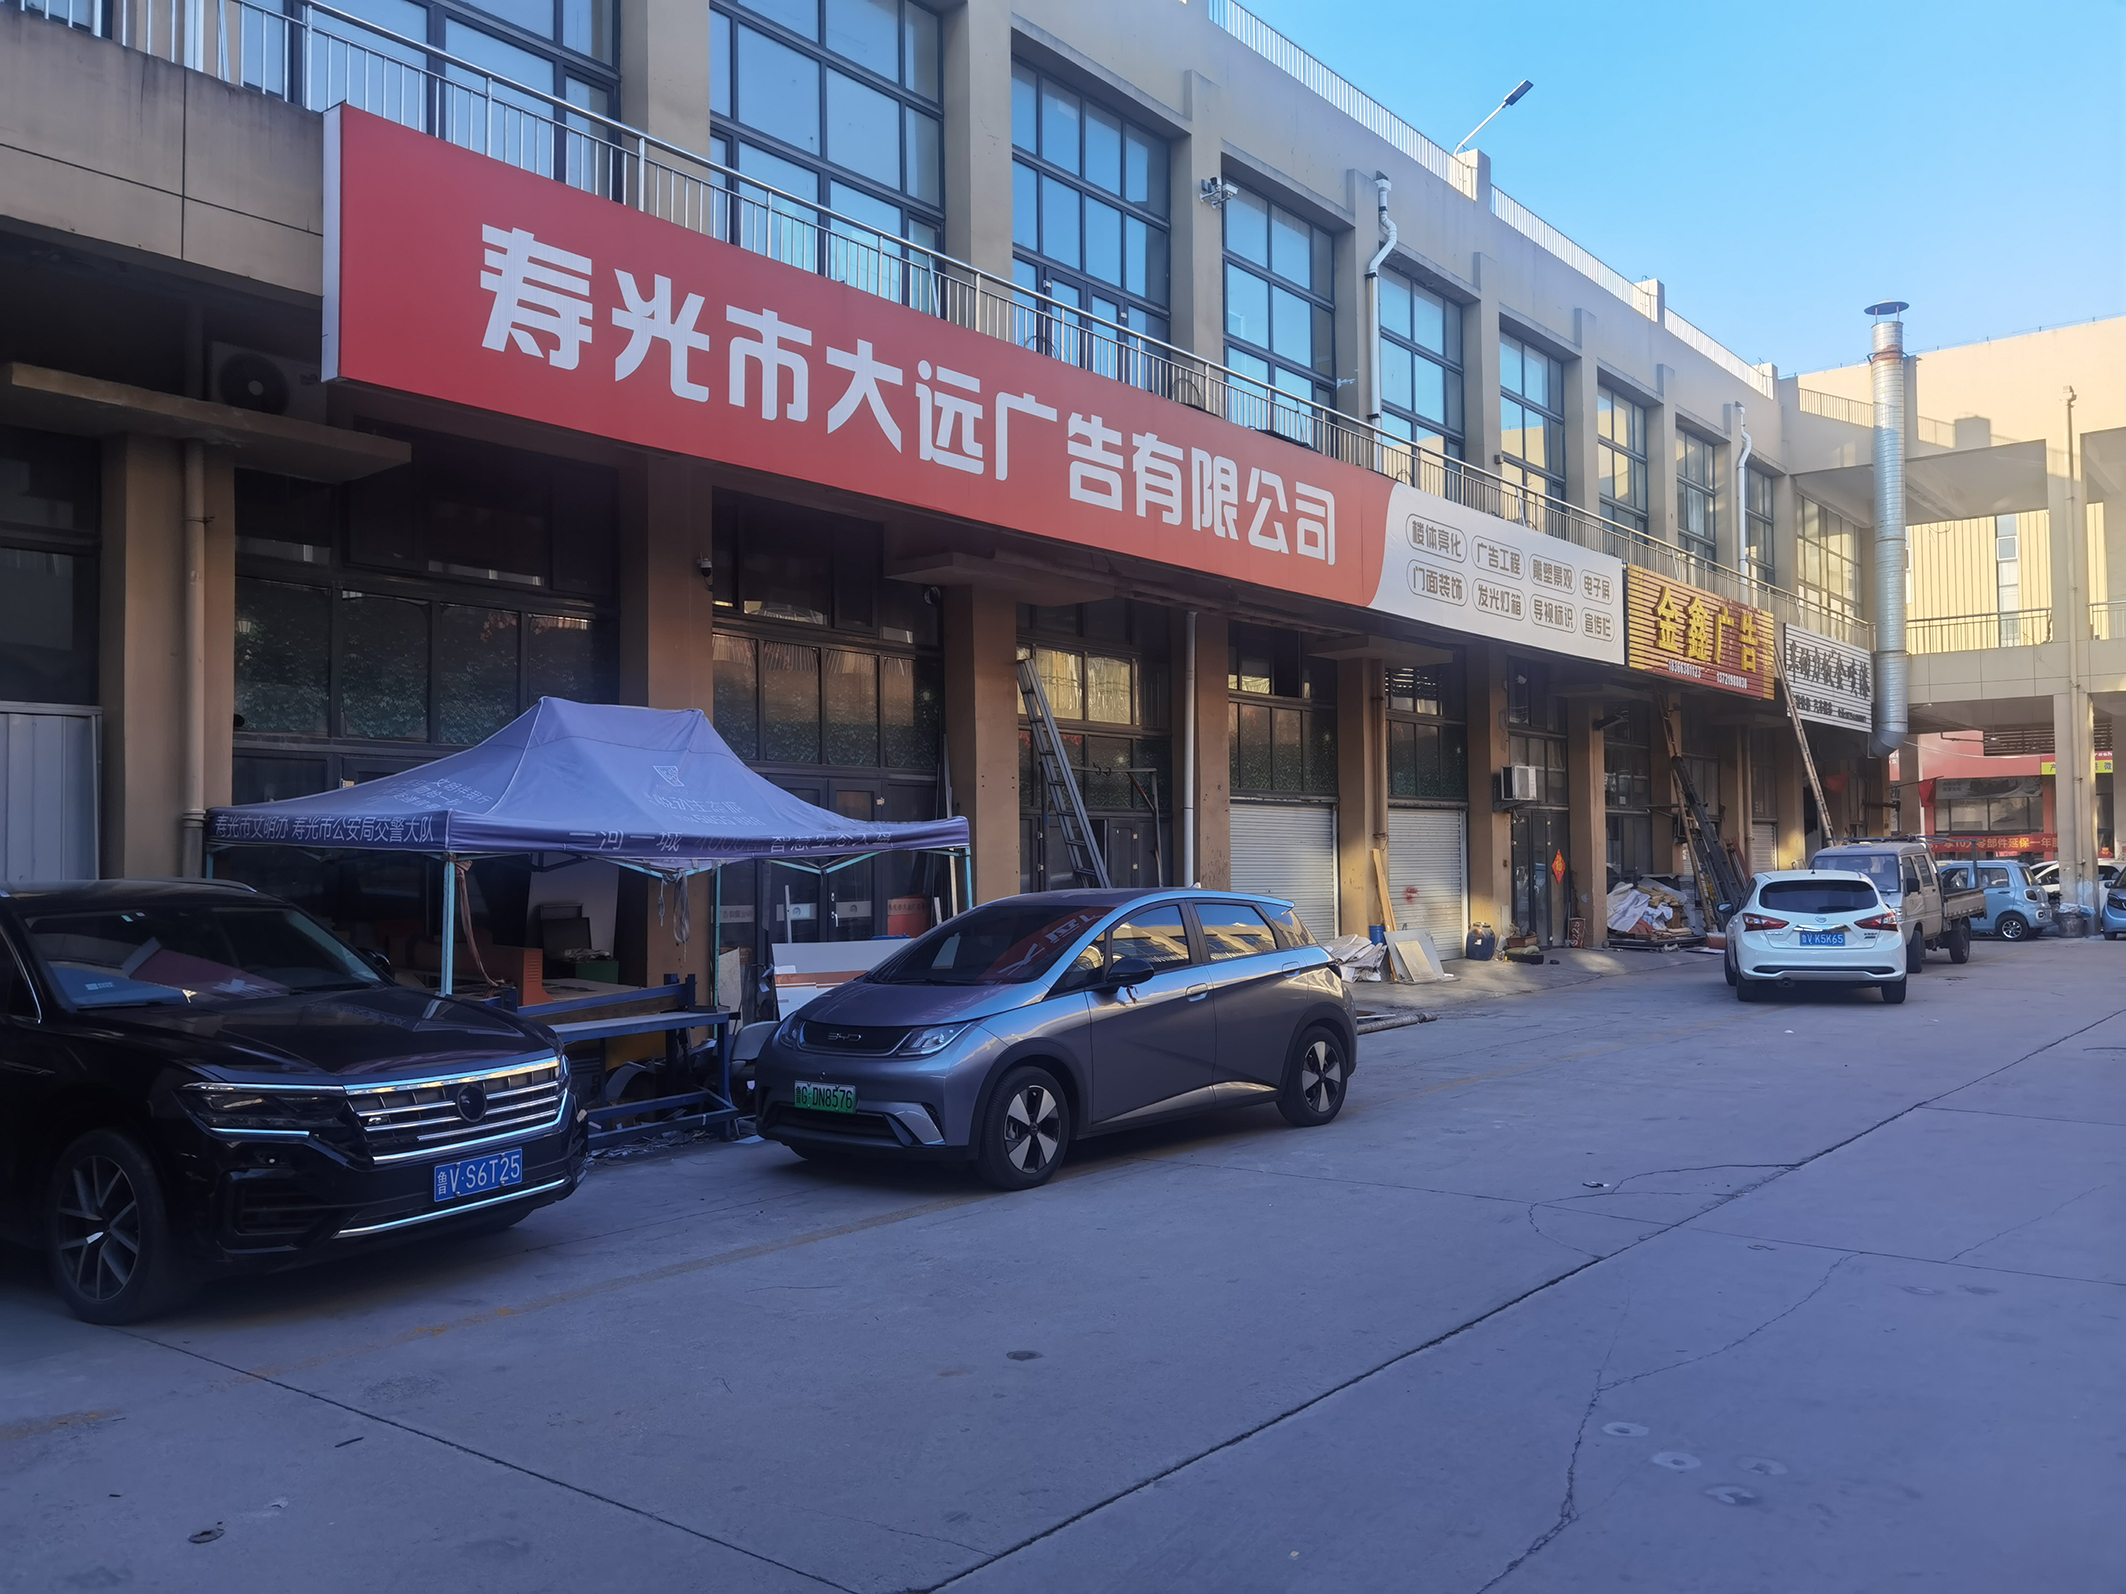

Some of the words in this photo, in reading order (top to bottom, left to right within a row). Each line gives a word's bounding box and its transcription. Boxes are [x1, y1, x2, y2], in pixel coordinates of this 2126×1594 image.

[480, 224, 1335, 565] 寿光市大远广告有限公司
[1412, 520, 1462, 557] 楼体亮化
[1477, 542, 1521, 575] 广告工程
[1533, 559, 1573, 590] 雕塑景观
[1584, 575, 1611, 600] 电子屏
[1413, 565, 1463, 601] 门面装饰
[1477, 584, 1521, 616] 发光灯箱
[1533, 602, 1573, 629] 导视标识
[1585, 613, 1611, 637] 宣传栏
[1654, 586, 1759, 673] 金鑫广告
[215, 814, 289, 840] 寿光市文明办
[292, 815, 434, 842] 寿光市公安局交警大队
[569, 829, 683, 851] 一河一城
[437, 1154, 520, 1196] 鲁V·S6T25
